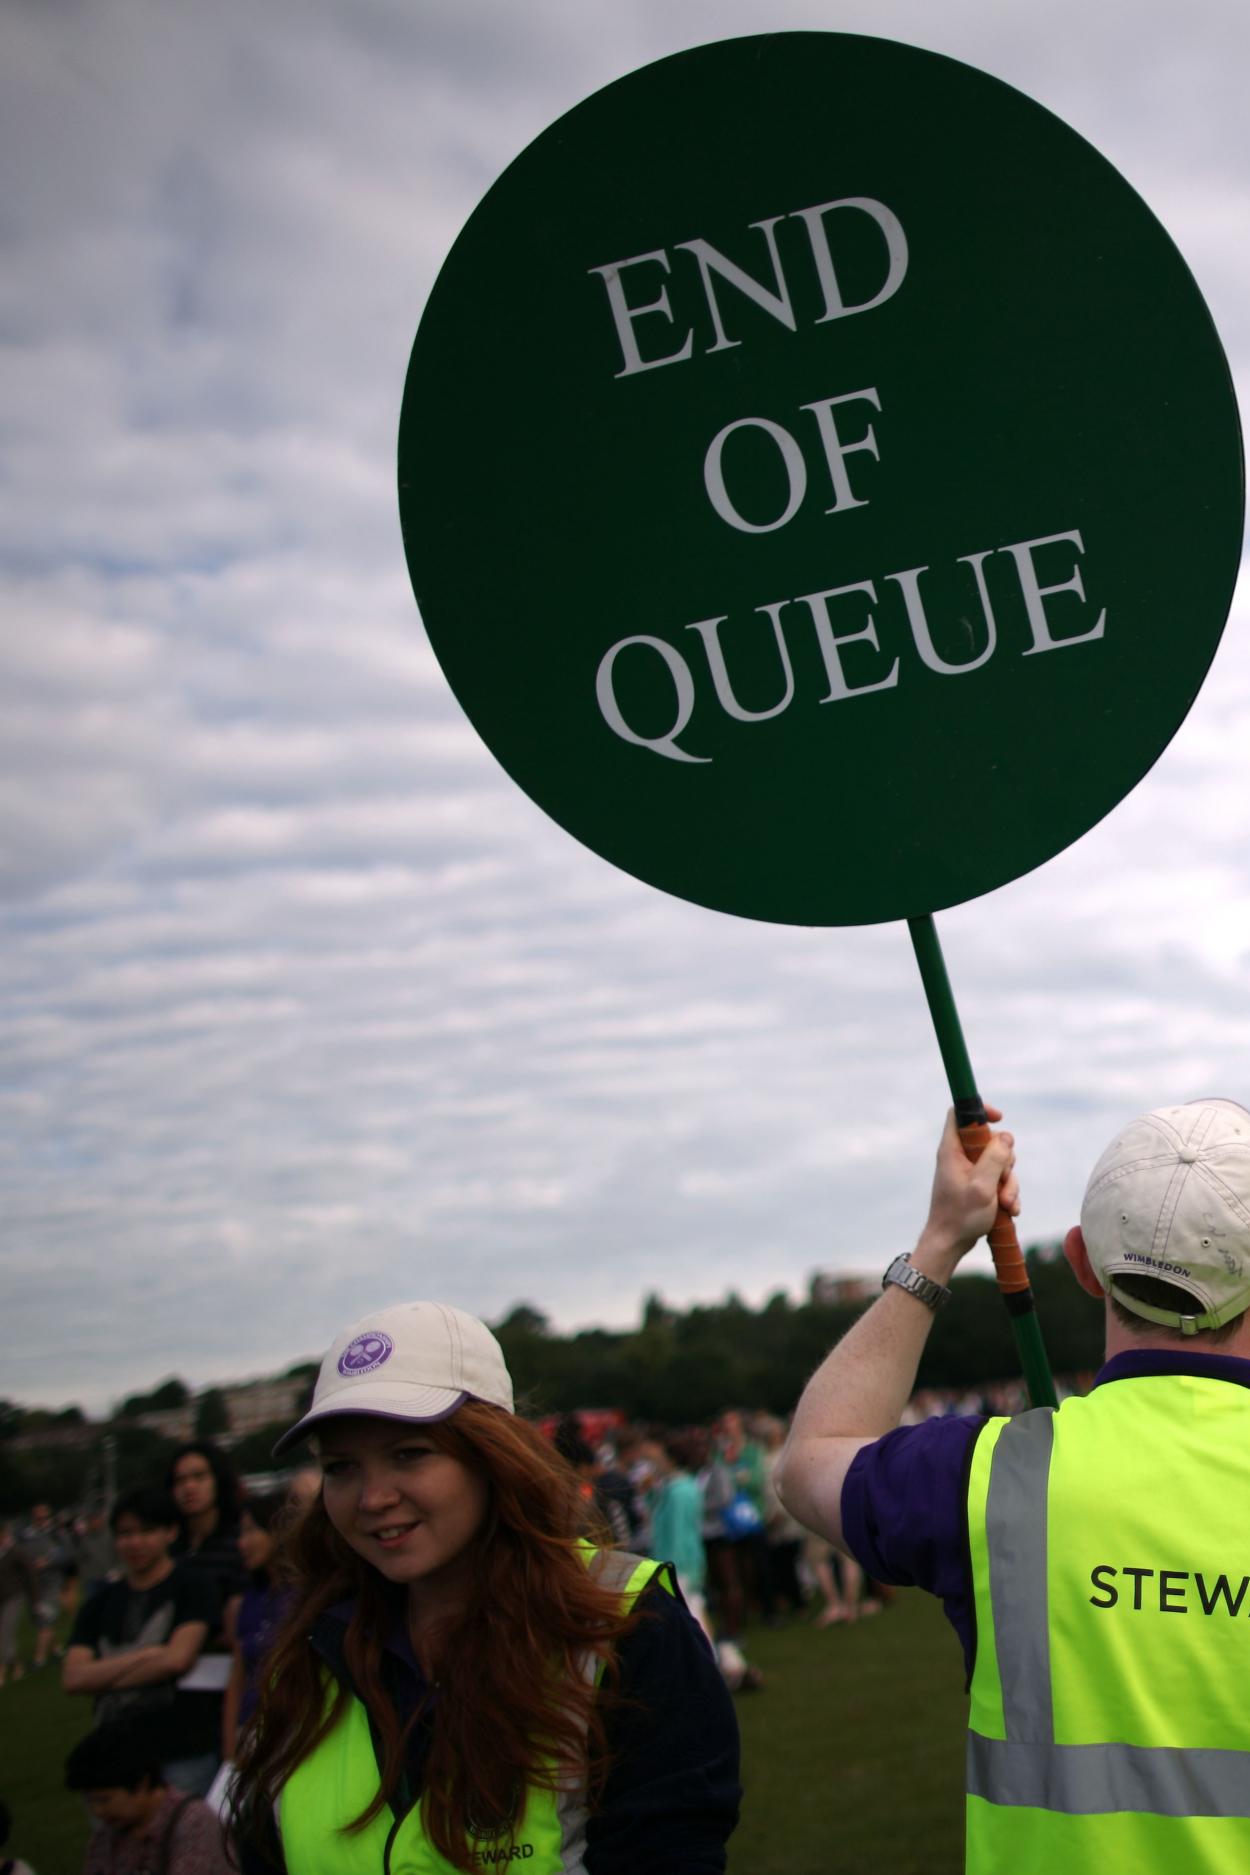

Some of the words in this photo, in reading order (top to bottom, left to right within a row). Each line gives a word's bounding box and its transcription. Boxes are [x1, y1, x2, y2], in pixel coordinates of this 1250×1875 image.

[588, 196, 908, 378] END
[704, 387, 882, 533] OF
[596, 529, 1106, 763] QUEUE
[1124, 1252, 1191, 1278] WIMBLEDON
[470, 1843, 534, 1867] EWARD
